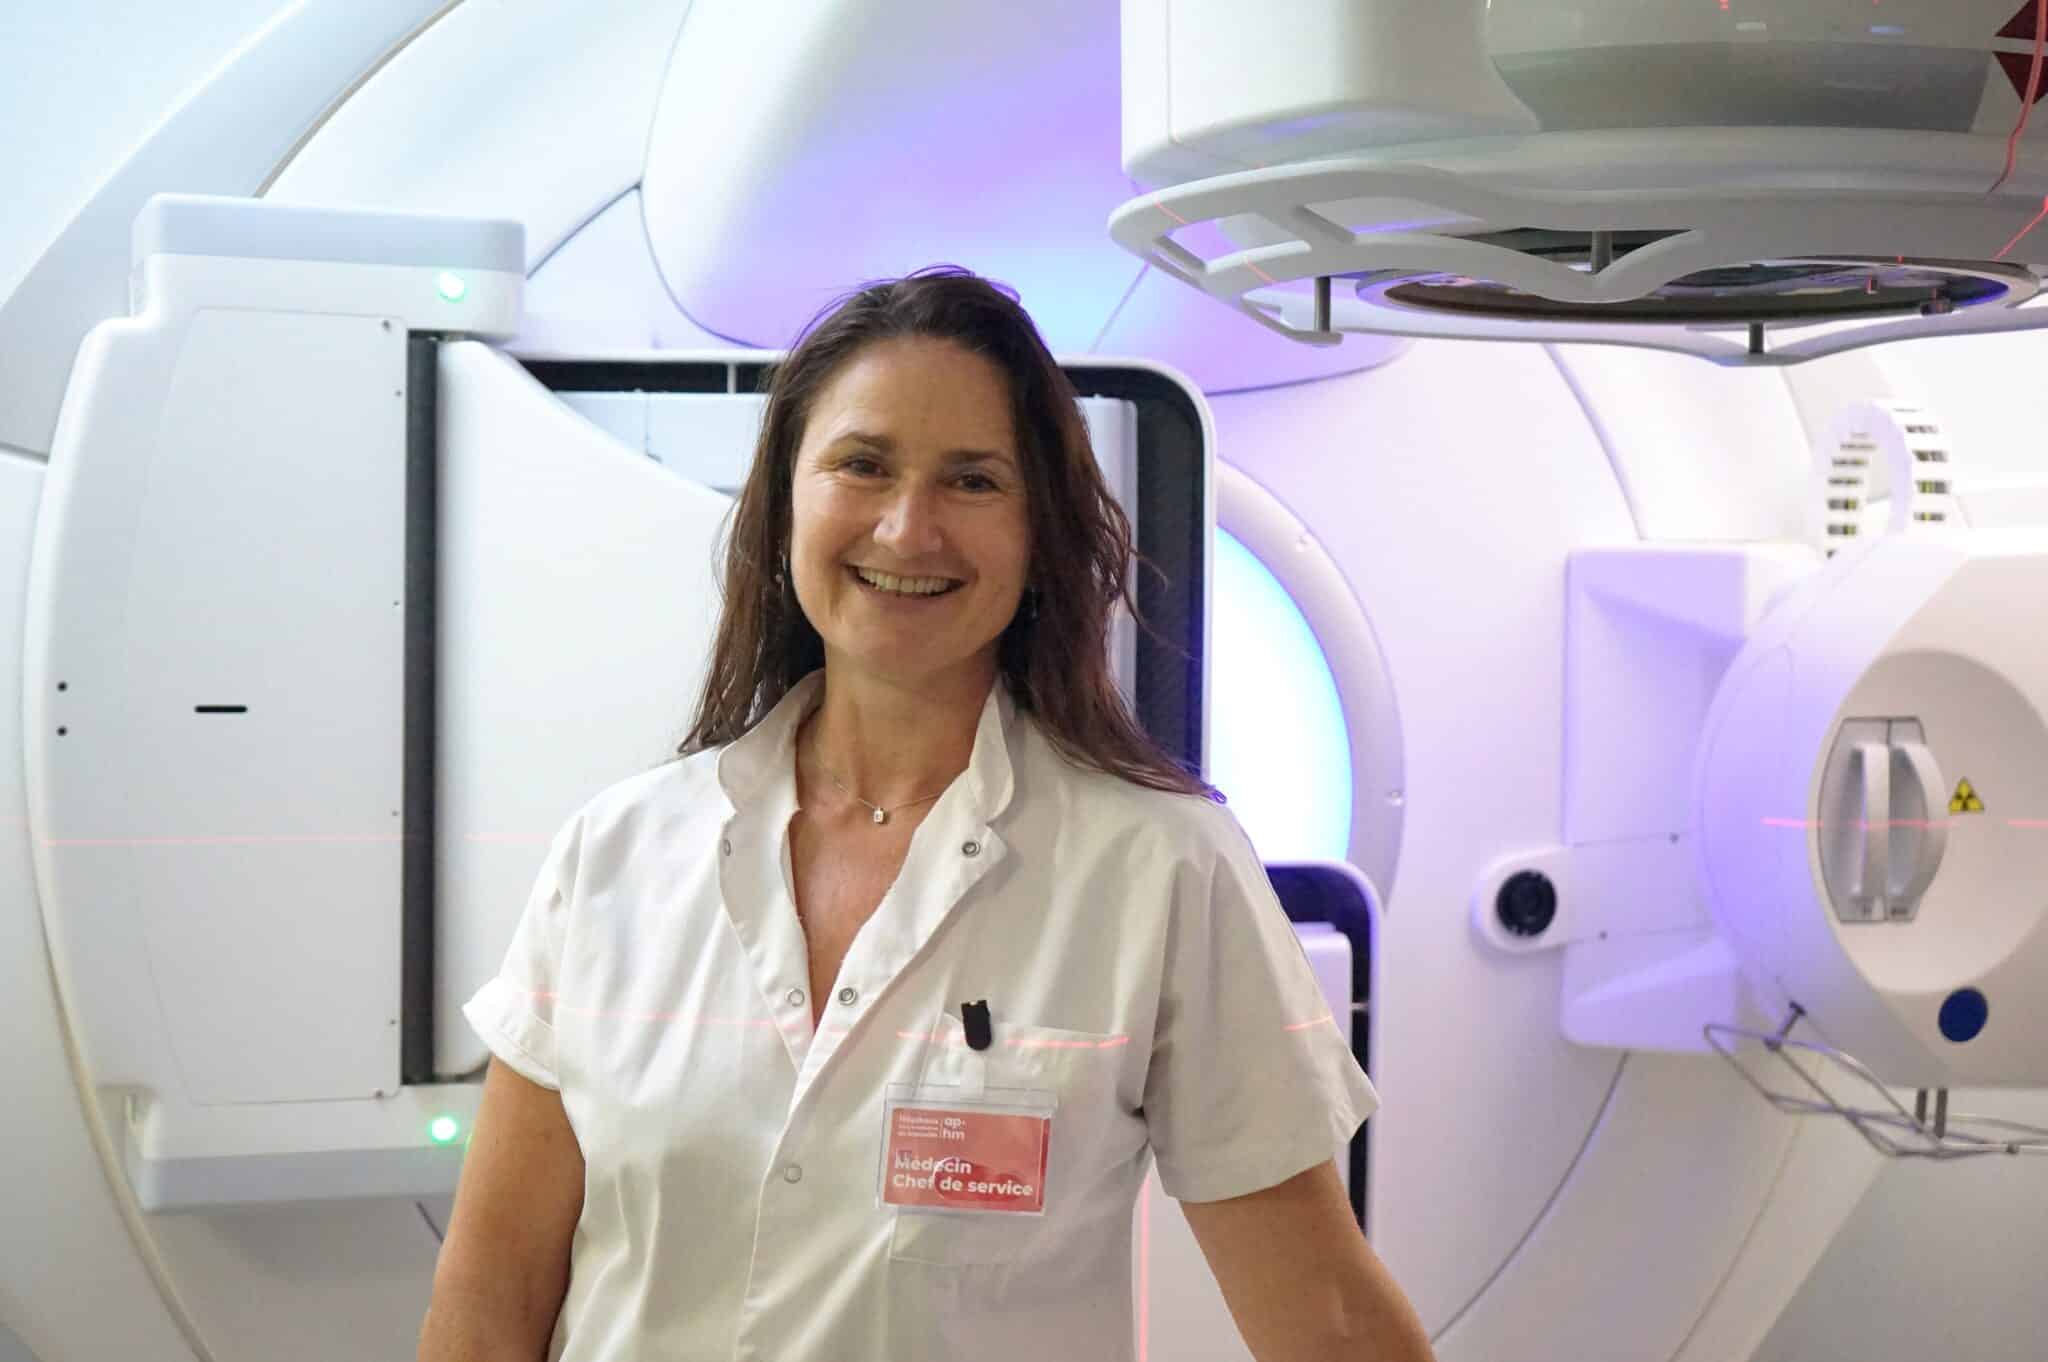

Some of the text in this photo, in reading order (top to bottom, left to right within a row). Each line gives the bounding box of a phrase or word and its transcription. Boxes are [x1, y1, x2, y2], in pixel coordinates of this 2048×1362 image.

[943, 1127, 965, 1140] hm
[892, 1173, 1033, 1196] Chef de service
